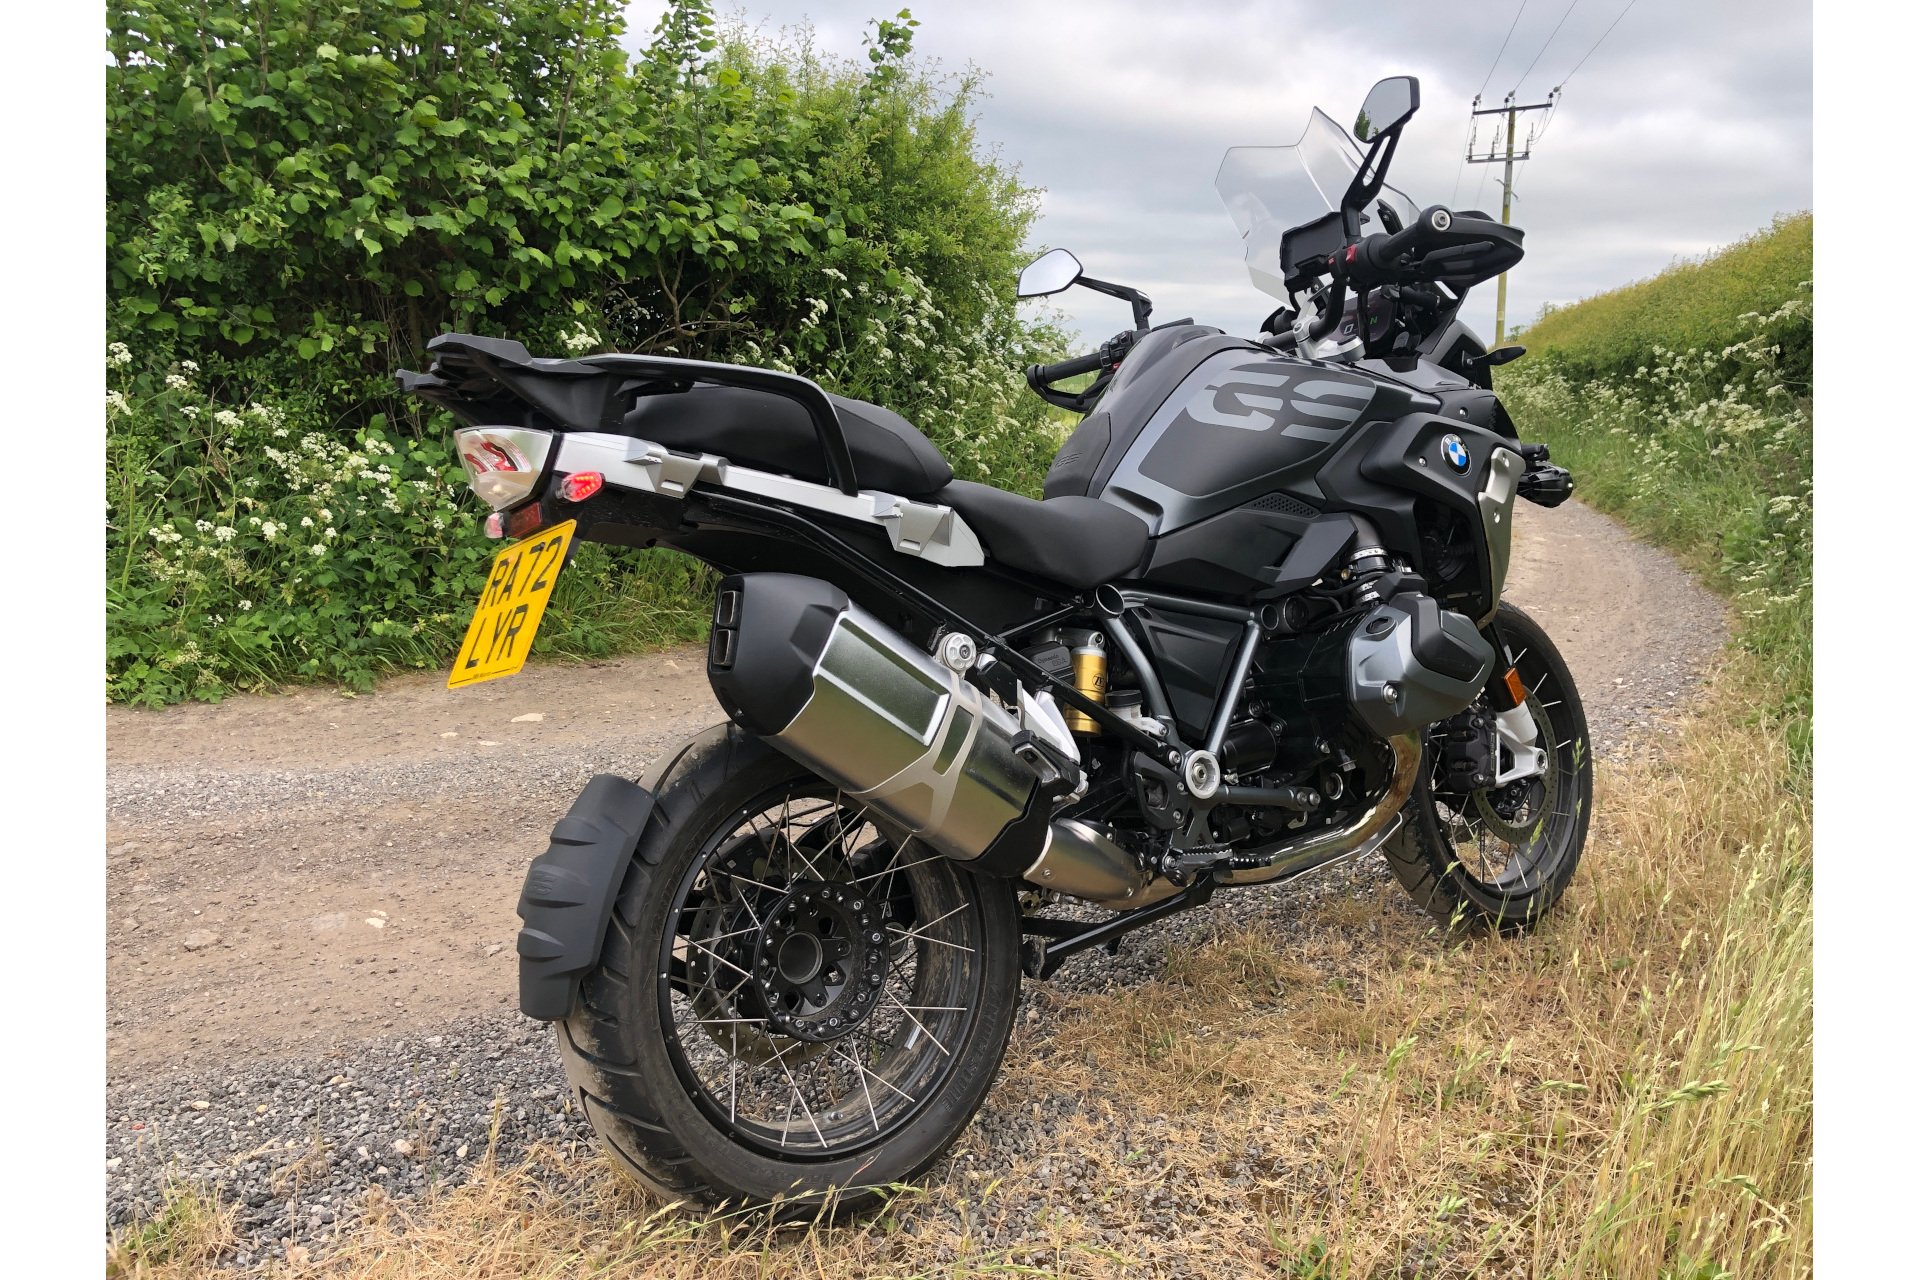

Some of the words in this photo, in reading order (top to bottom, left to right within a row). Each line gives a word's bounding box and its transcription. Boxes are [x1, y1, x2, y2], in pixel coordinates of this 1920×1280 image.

[1369, 315, 1379, 325] N
[1185, 371, 1376, 443] GS
[482, 535, 563, 610] RA72
[465, 603, 529, 669] LYR
[1092, 674, 1105, 688] ZF
